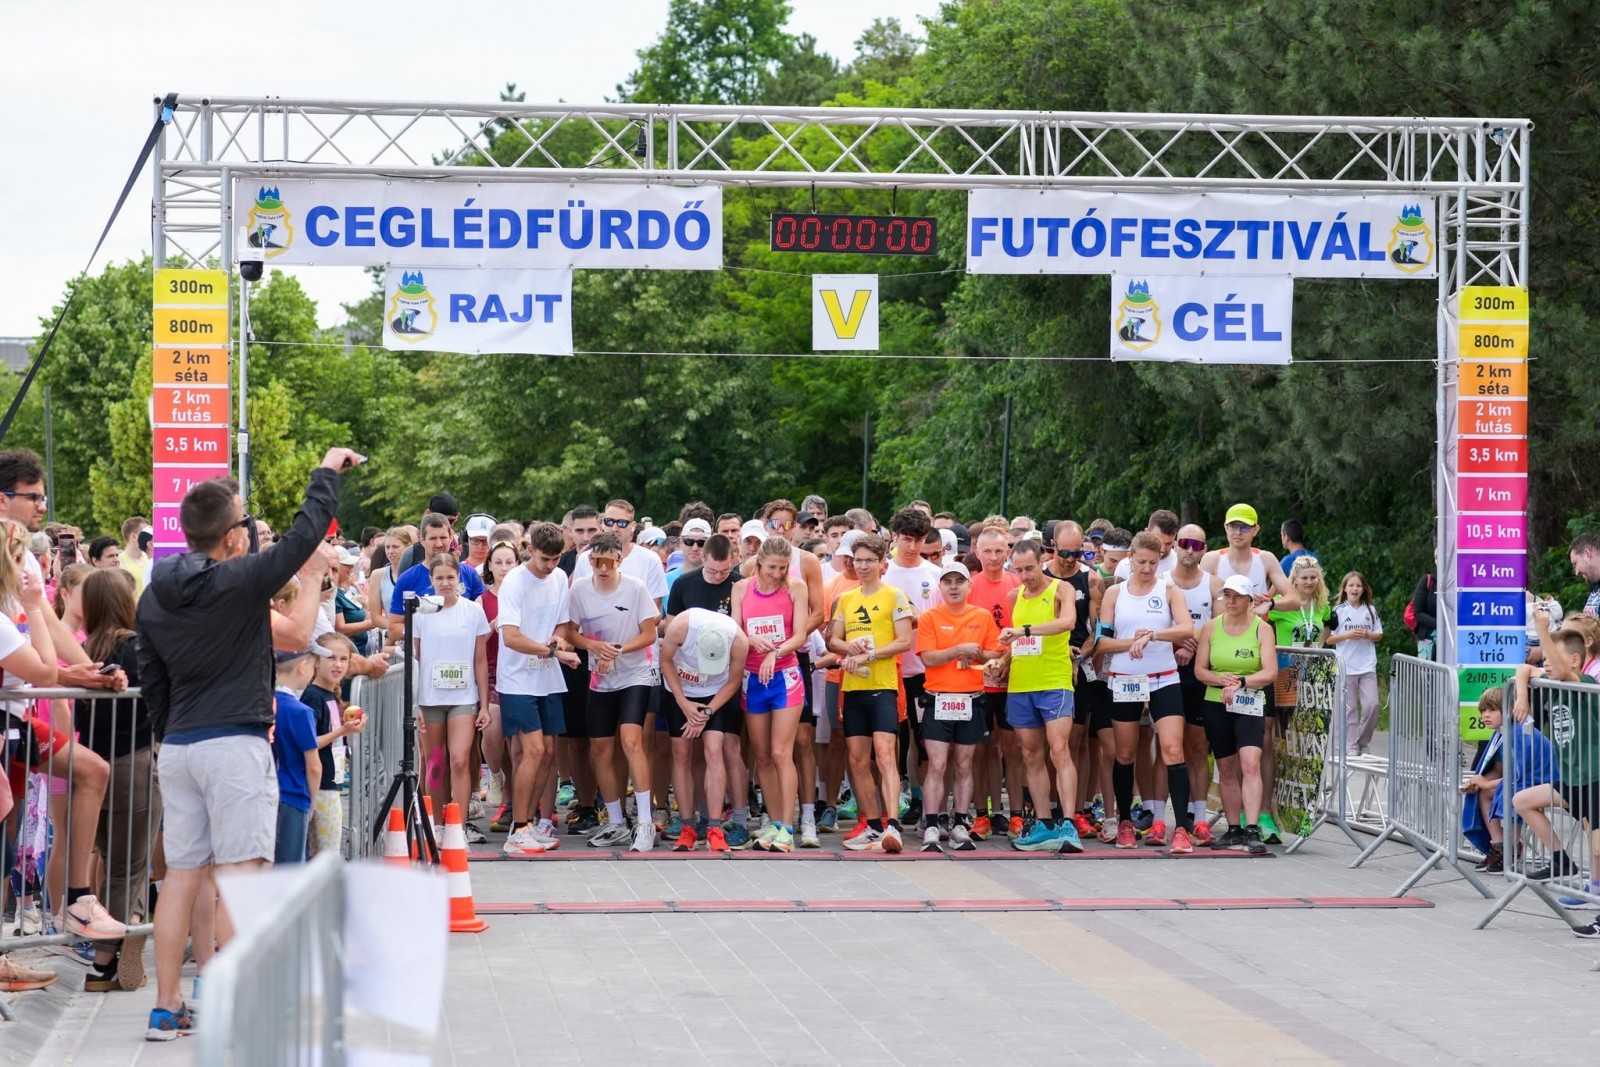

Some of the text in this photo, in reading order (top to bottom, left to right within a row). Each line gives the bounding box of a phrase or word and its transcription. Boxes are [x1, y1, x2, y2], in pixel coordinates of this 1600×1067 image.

[305, 197, 711, 251] CEGLÉDFÜRDŐ
[971, 207, 1386, 262] FUTÓFESZTIVÁL
[169, 280, 213, 294] 300m
[449, 292, 563, 324] RAJT
[1474, 297, 1515, 310] 300m
[820, 289, 873, 340] V
[1172, 293, 1282, 343] CÉL
[169, 319, 213, 333] 800m
[1474, 335, 1514, 348] 800m
[173, 351, 211, 364] 2 km
[175, 368, 208, 382] séta
[1476, 365, 1511, 378] 2 km
[1478, 381, 1510, 395] séta
[173, 390, 211, 404] 2 km
[172, 407, 211, 422] futás
[1476, 403, 1511, 416] 2 km
[1475, 419, 1512, 433] futás
[165, 437, 218, 453] 3,5 km
[1469, 448, 1518, 464] 3,5 km
[173, 479, 201, 492] 7 k
[1476, 488, 1511, 501] 7 km
[162, 516, 182, 532] 10,
[1466, 525, 1521, 540] 10,5 km
[1471, 564, 1515, 577] 14 km
[1472, 602, 1514, 616] 21 km
[754, 624, 777, 635] 21041
[1016, 637, 1036, 646] 1006
[1468, 632, 1518, 645] 3x7 km
[1479, 648, 1505, 663] trió
[440, 669, 463, 679] 14001
[677, 668, 700, 683] 21078
[1466, 672, 1497, 687] 2x10,5
[1122, 683, 1140, 692] 7109
[941, 701, 966, 711] 21049
[1235, 694, 1255, 706] 7008
